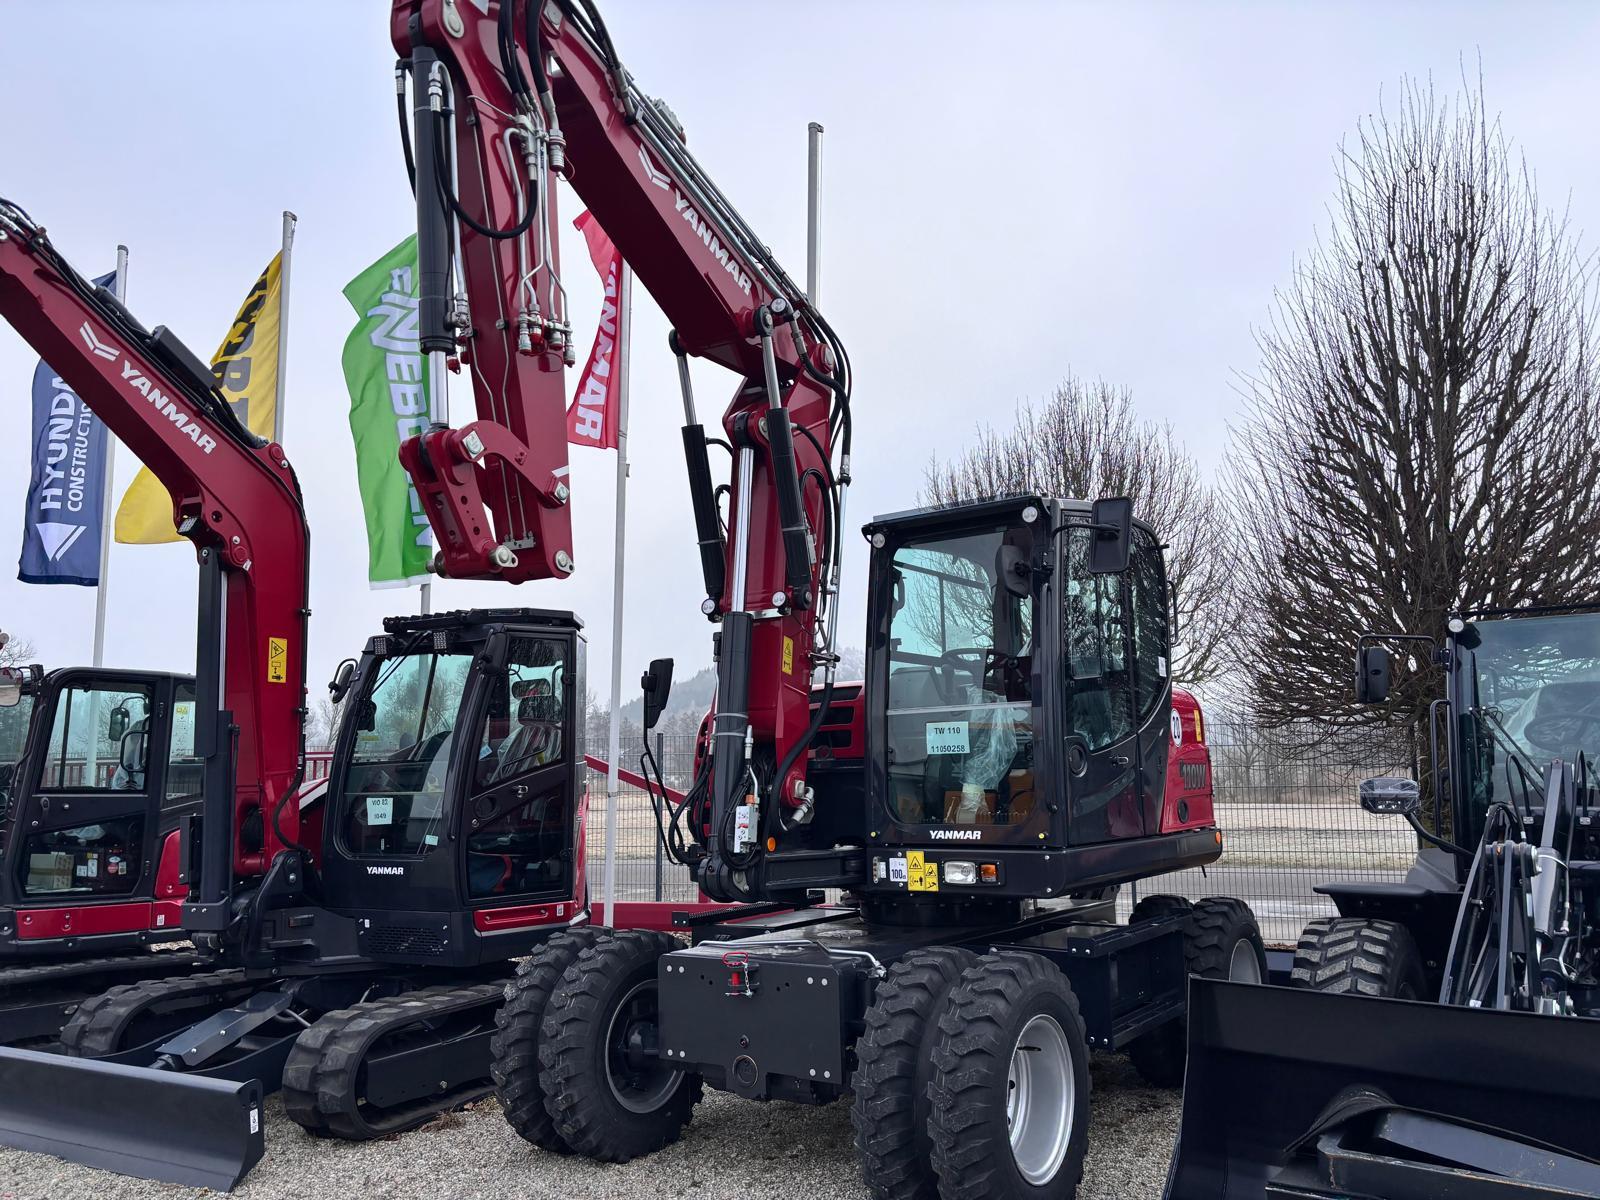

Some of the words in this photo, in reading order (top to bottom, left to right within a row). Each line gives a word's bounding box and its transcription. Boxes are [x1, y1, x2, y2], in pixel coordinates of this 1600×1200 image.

[674, 187, 752, 297] YANMAR
[121, 360, 217, 454] YANMAR
[934, 727, 946, 735] TW
[948, 726, 961, 734] 110
[929, 830, 982, 840] YANMAR
[366, 866, 404, 875] YANMAR
